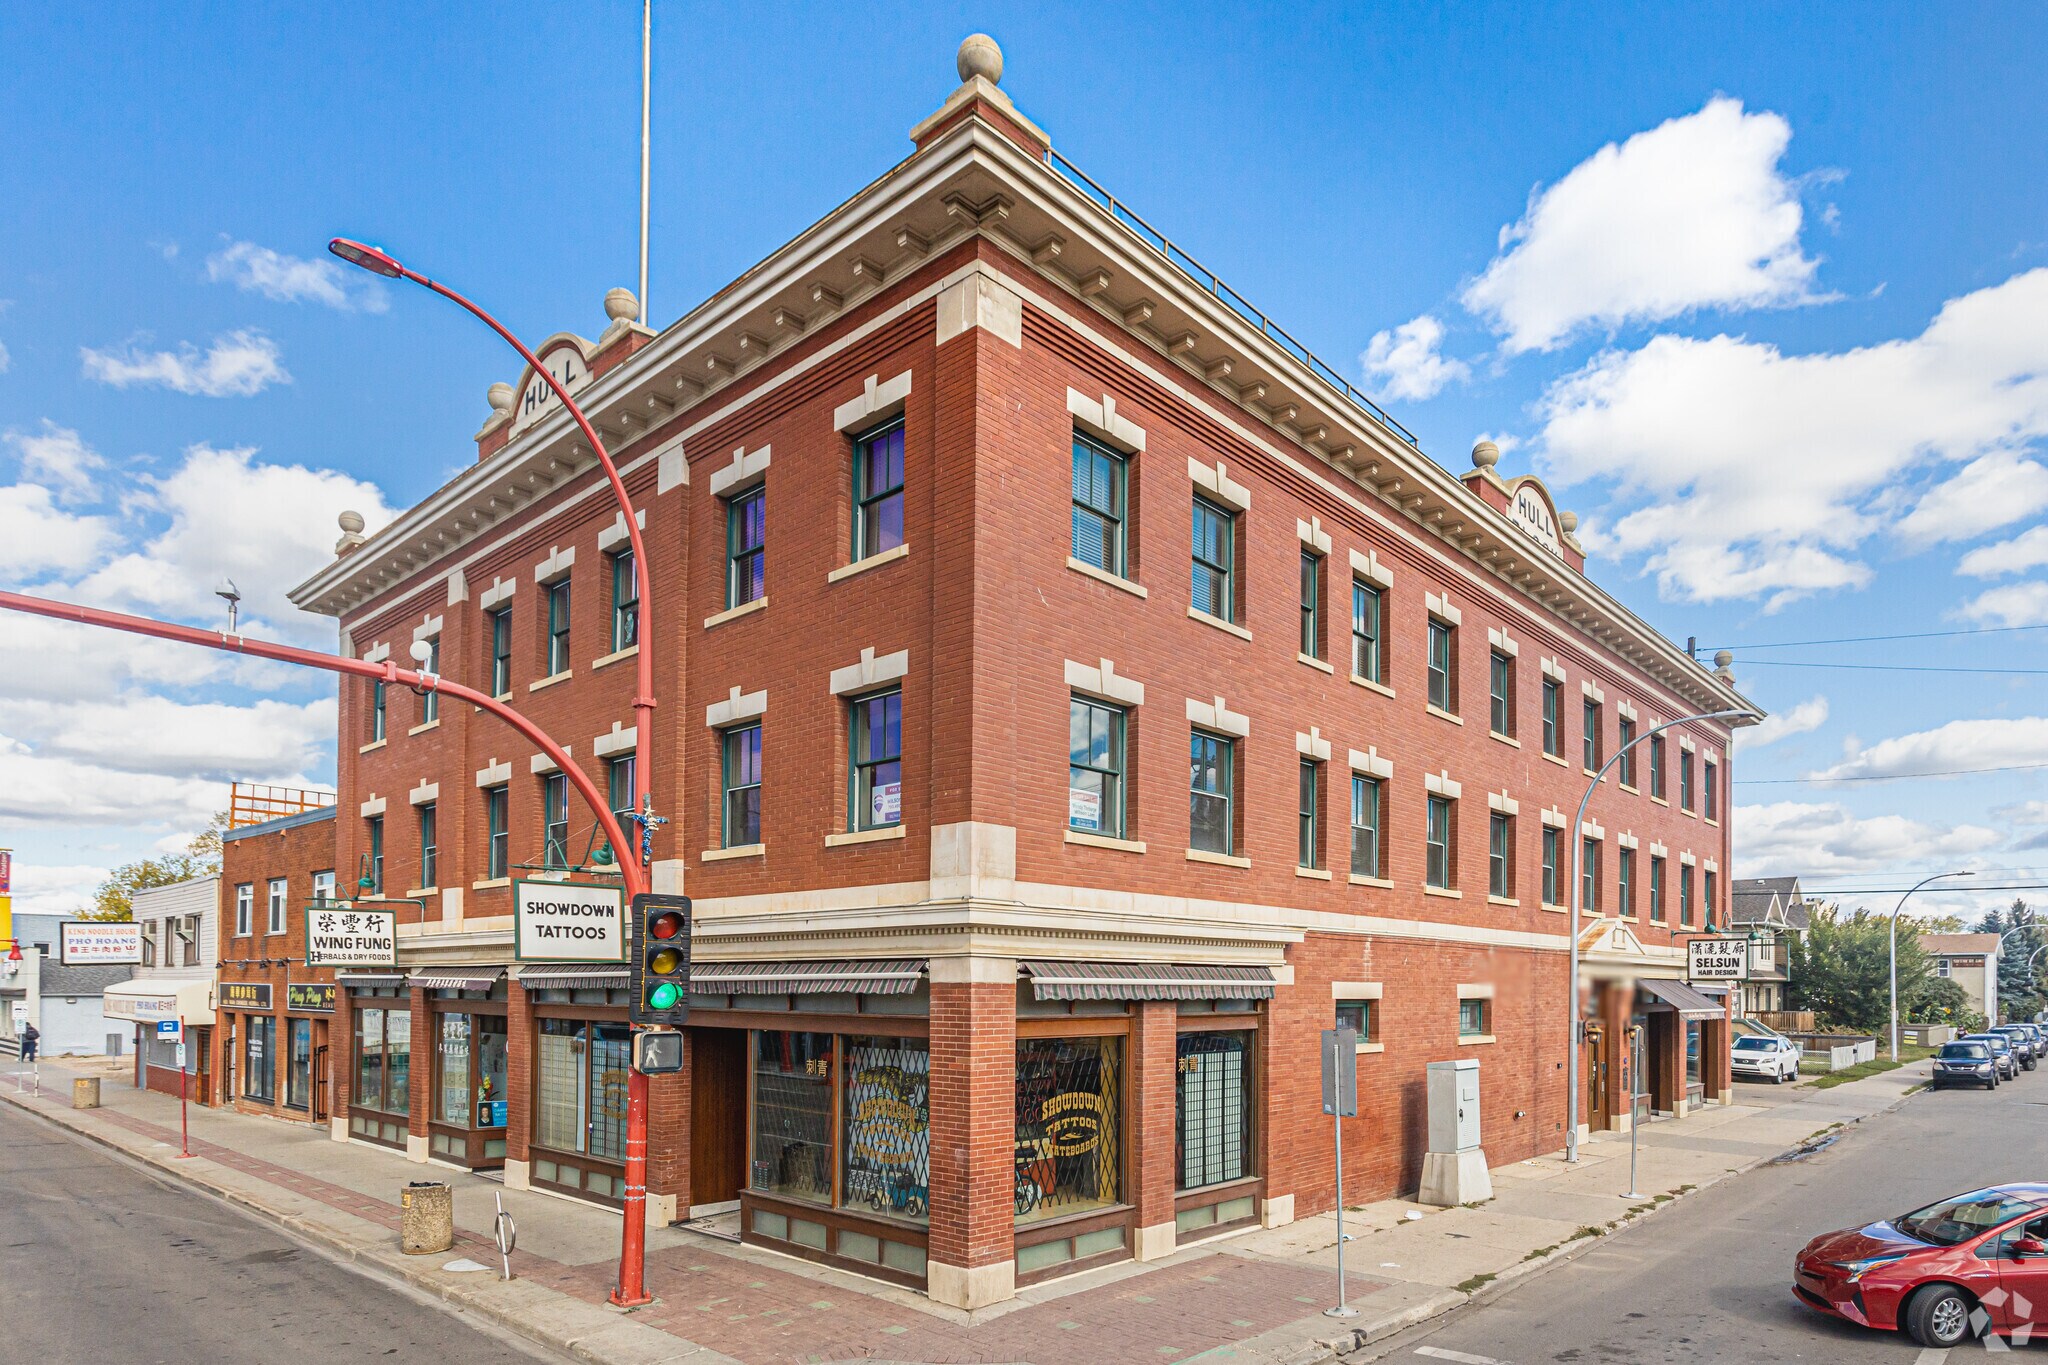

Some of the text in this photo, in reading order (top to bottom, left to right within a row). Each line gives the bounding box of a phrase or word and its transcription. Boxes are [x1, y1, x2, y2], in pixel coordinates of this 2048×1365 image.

[1518, 493, 1553, 538] HULL
[527, 901, 615, 918] SHOWDOWN
[318, 913, 385, 934] 榮豐行
[88, 928, 113, 936] NOODLE
[115, 928, 136, 936] HOUSE
[535, 925, 606, 940] TATTOOS
[95, 937, 137, 945] HOANG
[313, 936, 391, 950] WING FUNG
[310, 951, 391, 962] HERBALS & DRY FOODS
[1696, 957, 1740, 968] SELSUN
[322, 1001, 335, 1009] BEAU
[806, 1059, 828, 1077] 刺青
[1178, 1056, 1198, 1073] 刺青
[1042, 1092, 1101, 1121] SHOWDOWN
[1045, 1116, 1097, 1137] TATTOOS
